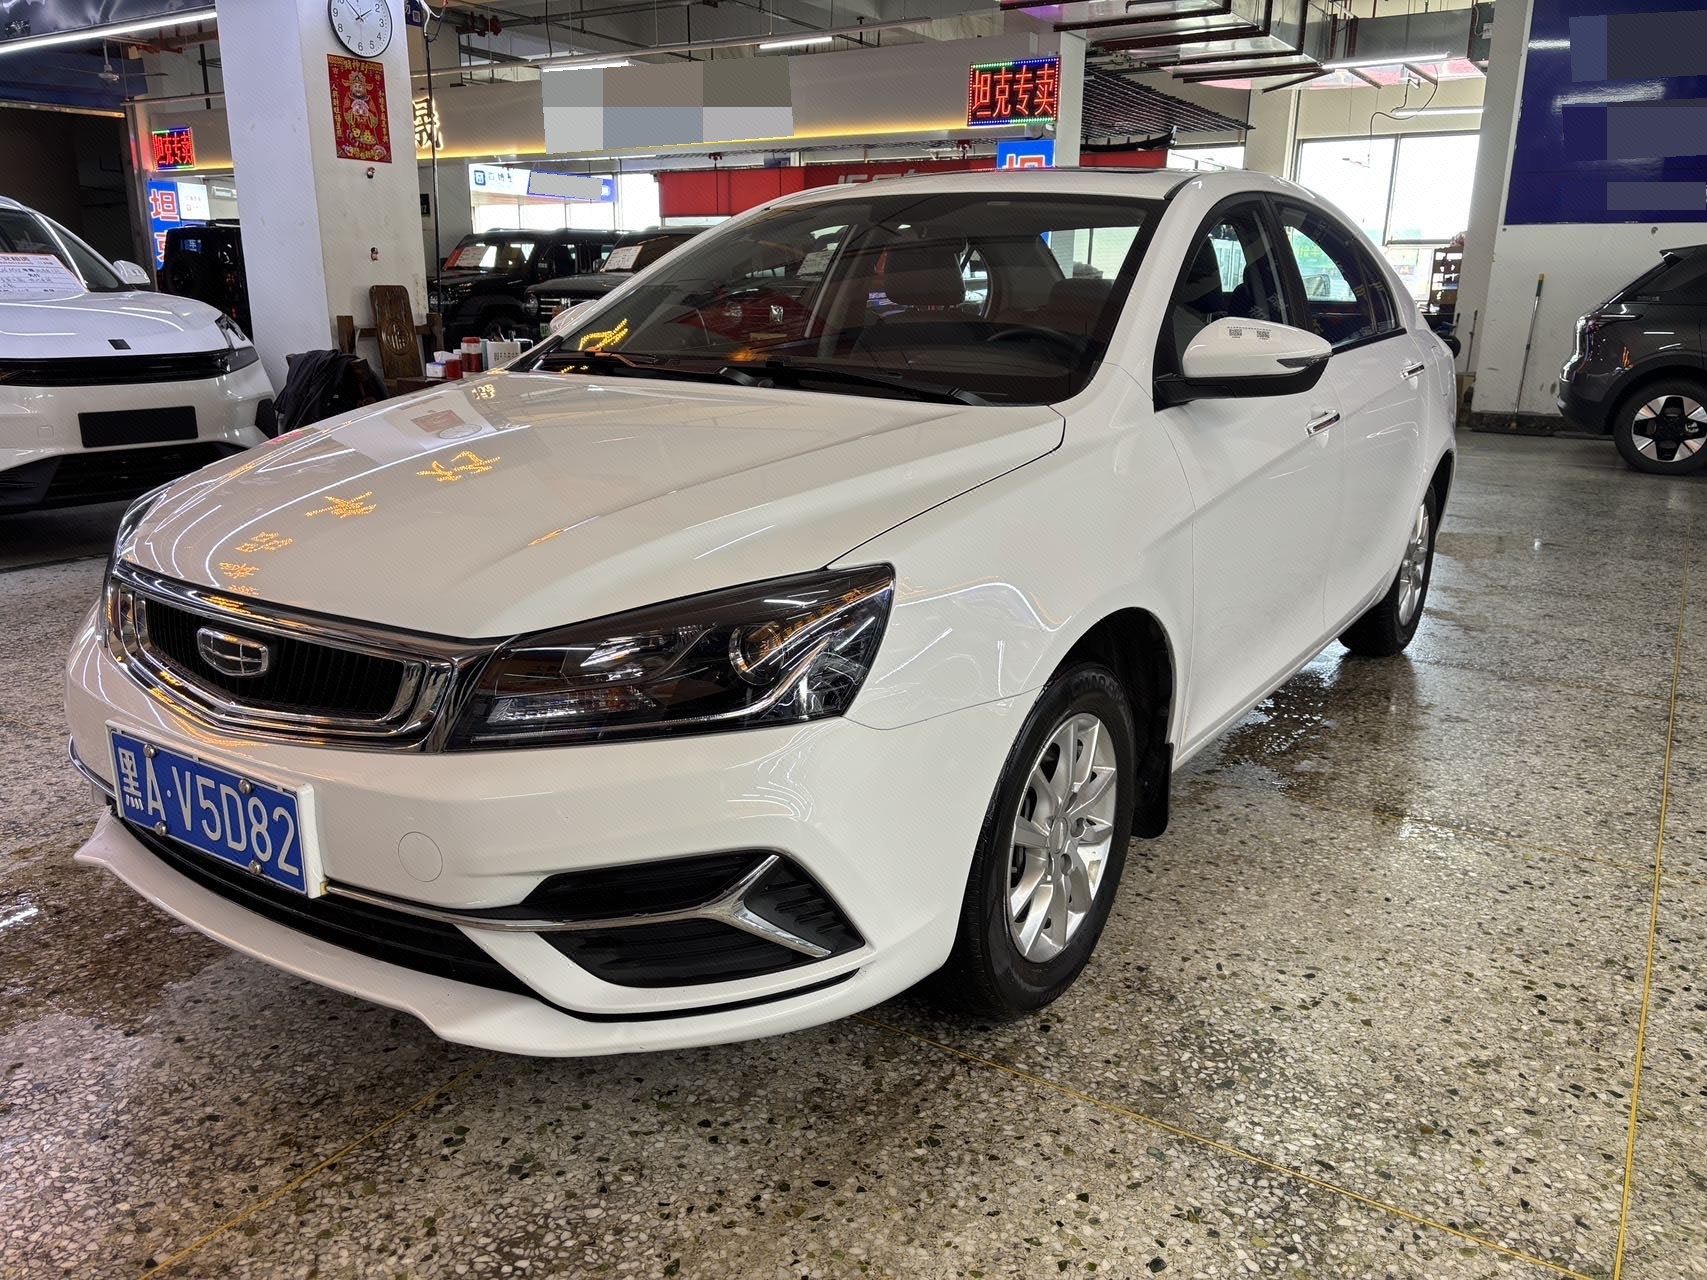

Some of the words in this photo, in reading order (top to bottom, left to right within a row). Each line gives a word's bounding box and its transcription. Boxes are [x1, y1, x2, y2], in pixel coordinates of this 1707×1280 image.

[333, 8, 338, 17] 9
[374, 3, 380, 13] 2
[337, 24, 343, 33] 8
[379, 19, 384, 28] 3
[346, 35, 351, 45] 7
[376, 32, 382, 41] 4
[358, 41, 364, 51] 6
[369, 40, 375, 50] 5
[971, 64, 1055, 117] 坦克专卖
[154, 132, 192, 165] 坦克专卖
[118, 746, 300, 877] 黑A·V5D82
